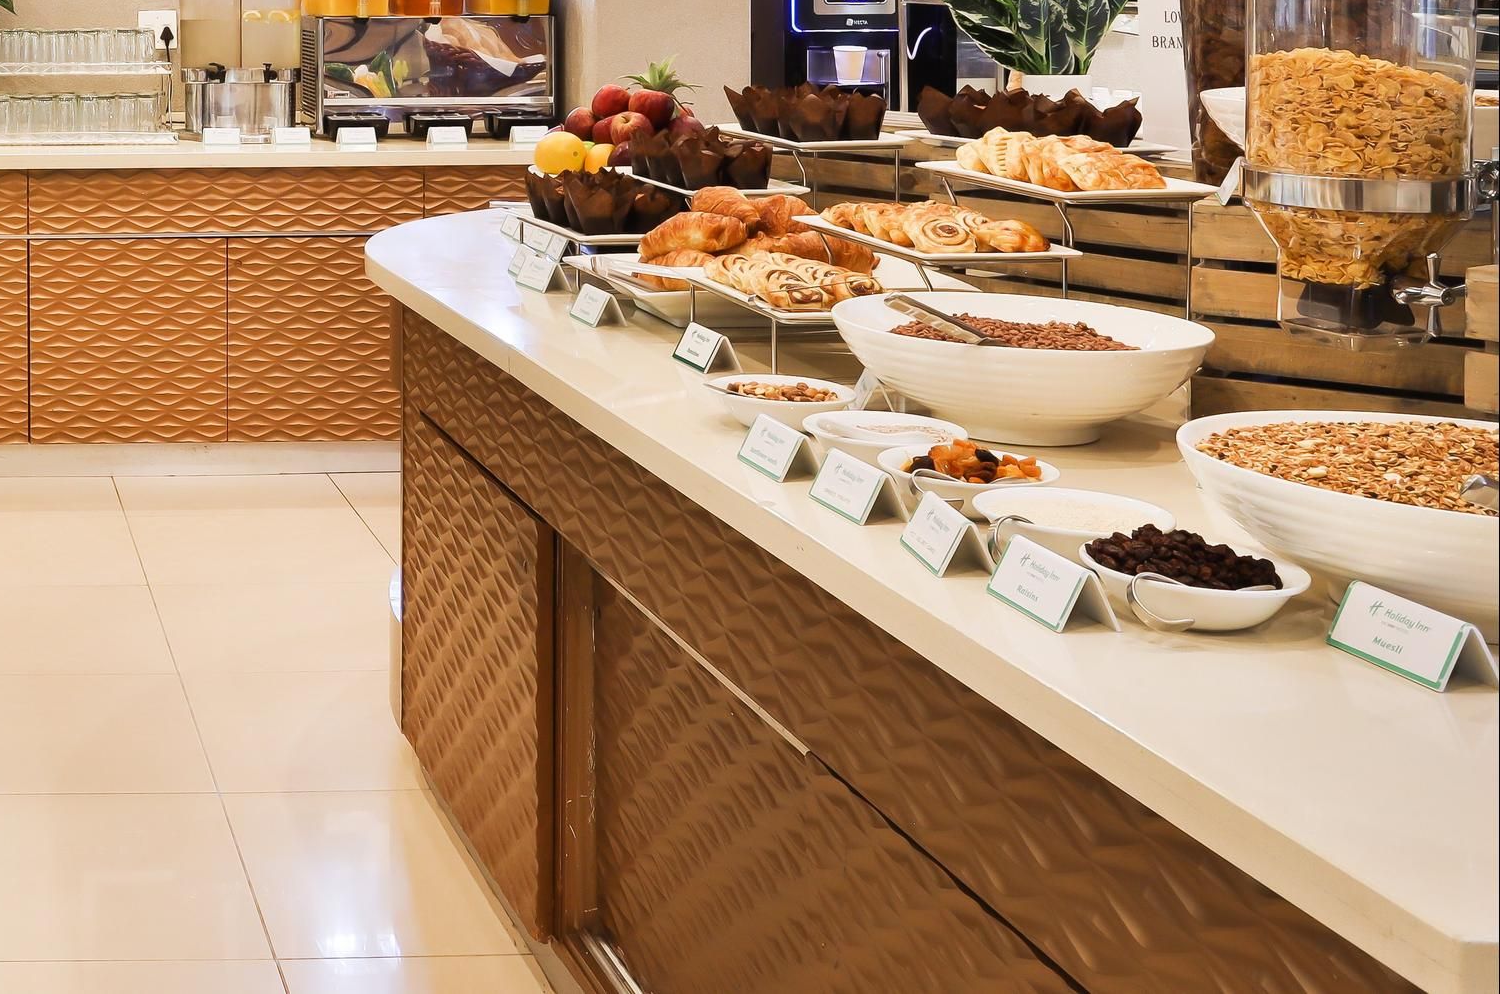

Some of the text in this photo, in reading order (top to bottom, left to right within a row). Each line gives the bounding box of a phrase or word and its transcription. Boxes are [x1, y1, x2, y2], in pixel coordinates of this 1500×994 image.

[1029, 560, 1051, 579] Holiday
[1015, 584, 1040, 602] Raisins
[1384, 608, 1417, 630] Holiday
[1414, 619, 1431, 633] Inn
[1372, 635, 1404, 655] Muesli
